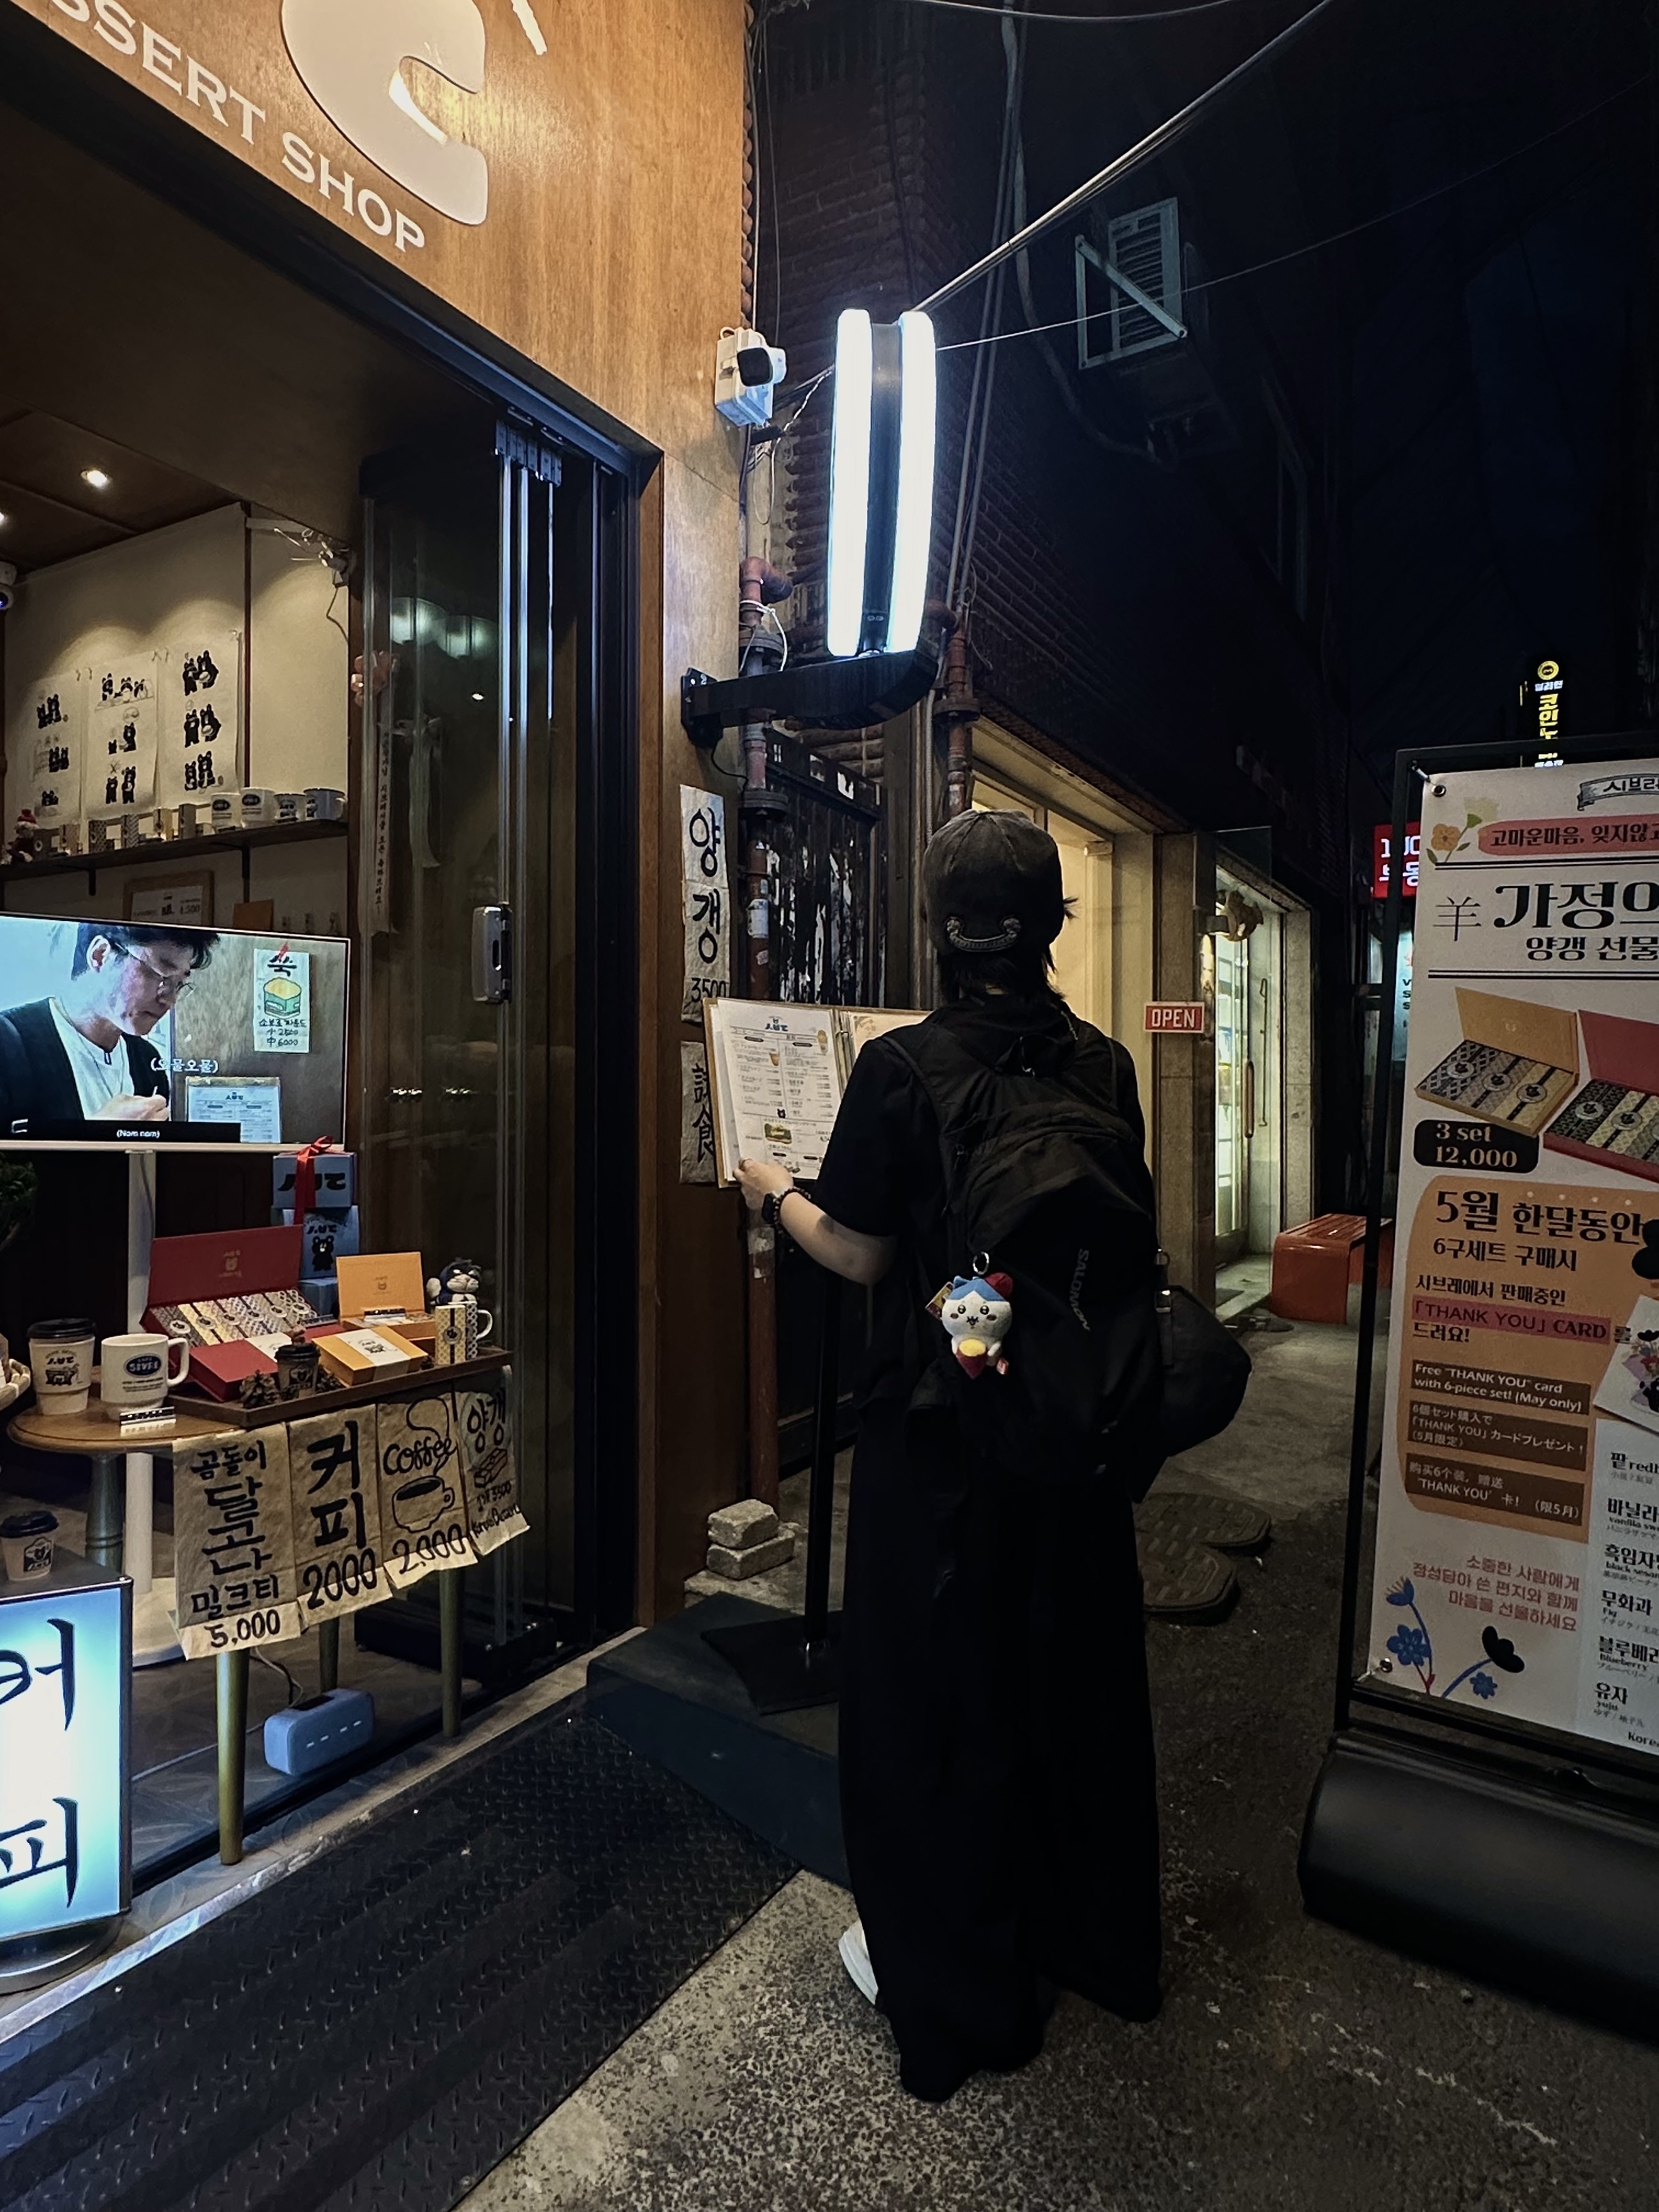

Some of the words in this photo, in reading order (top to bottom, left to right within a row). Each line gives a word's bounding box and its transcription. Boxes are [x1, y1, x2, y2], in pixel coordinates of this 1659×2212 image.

[281, 131, 426, 253] SHOP
[1491, 826, 1584, 847] 고마운마음,
[689, 808, 721, 964] 양갱
[1432, 896, 1482, 942] 羊
[1526, 936, 1587, 961] 양갱
[1596, 936, 1659, 961] 선물
[690, 978, 727, 1006] 3500
[1152, 1008, 1195, 1028] OPEN
[116, 1128, 139, 1139] (Nom
[140, 1129, 161, 1139] nom)
[1436, 1122, 1451, 1141] 3
[1456, 1124, 1493, 1142] set
[1435, 1146, 1518, 1168] 12,000
[1436, 1190, 1499, 1233] 5월
[1513, 1203, 1644, 1245] 한달동안
[1433, 1238, 1508, 1263] 6구세트
[1514, 1245, 1578, 1272] 구매시
[1415, 1274, 1494, 1299] 시브레에서
[1500, 1283, 1566, 1307] 판매중인
[1413, 1322, 1470, 1342] 드려요!
[1553, 1319, 1607, 1339] CARD
[1414, 1377, 1441, 1389] with
[1443, 1382, 1487, 1396] 6-piece
[1489, 1388, 1513, 1401] set!
[1515, 1391, 1547, 1408] (May
[1549, 1398, 1582, 1413] only)
[1415, 1363, 1442, 1376] Free
[1534, 1381, 1563, 1394] card
[190, 1439, 267, 1480] 곰돌이
[383, 1436, 458, 1475] Coffee
[307, 1419, 366, 1550] 커피
[201, 1476, 273, 1576] 달고나
[392, 1523, 466, 1575] 2,000
[1604, 1543, 1659, 1570] 흑임자
[303, 1547, 378, 1610] 2000
[1466, 1555, 1513, 1577] 소중한
[1516, 1564, 1580, 1592] 사람에게
[190, 1574, 279, 1621] 밀크티
[1496, 1579, 1542, 1604] 편지와
[1601, 1590, 1652, 1616] 무화과
[204, 1608, 281, 1649] 5,000
[1498, 1600, 1578, 1632] 선물하세요
[1594, 1681, 1628, 1705] 유자
